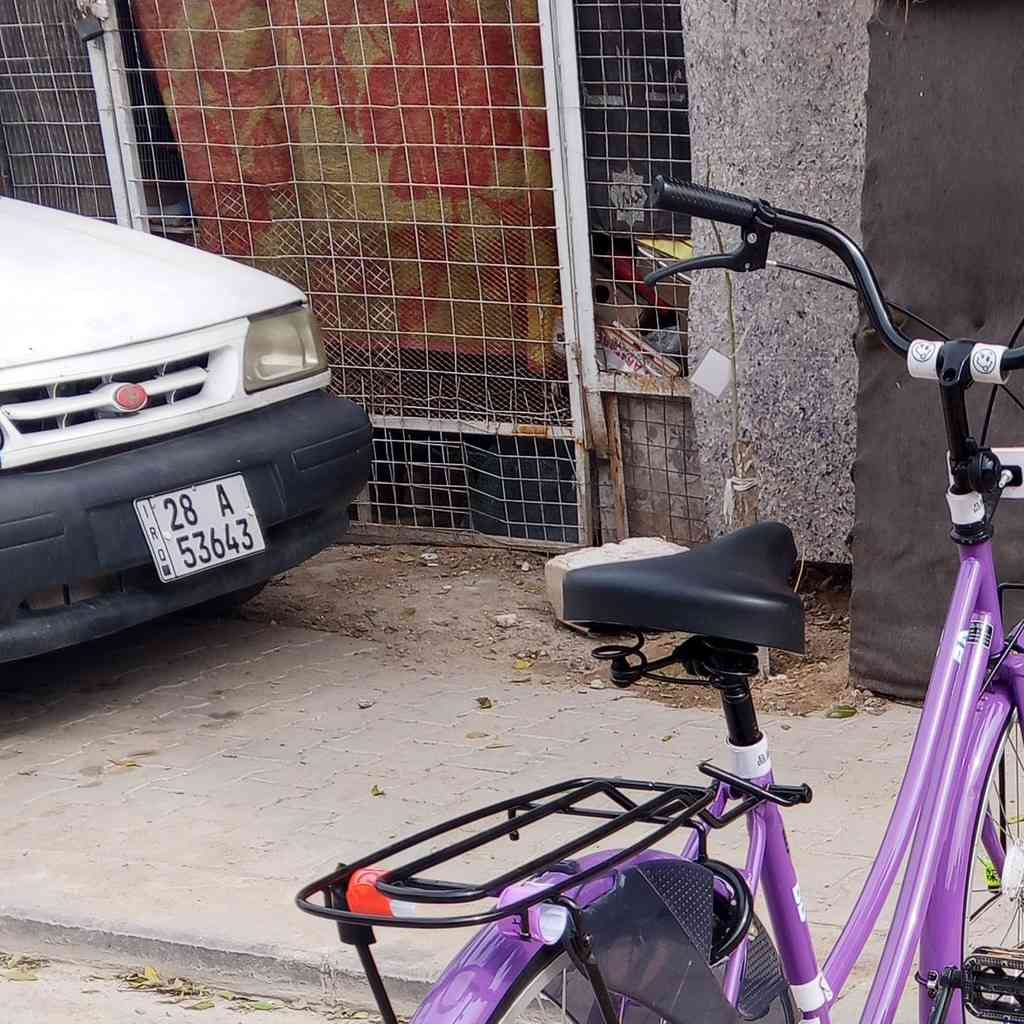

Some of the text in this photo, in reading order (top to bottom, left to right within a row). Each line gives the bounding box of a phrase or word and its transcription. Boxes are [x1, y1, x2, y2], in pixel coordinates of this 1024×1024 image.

[164, 483, 234, 531] 28 A
[176, 518, 254, 568] 53643
